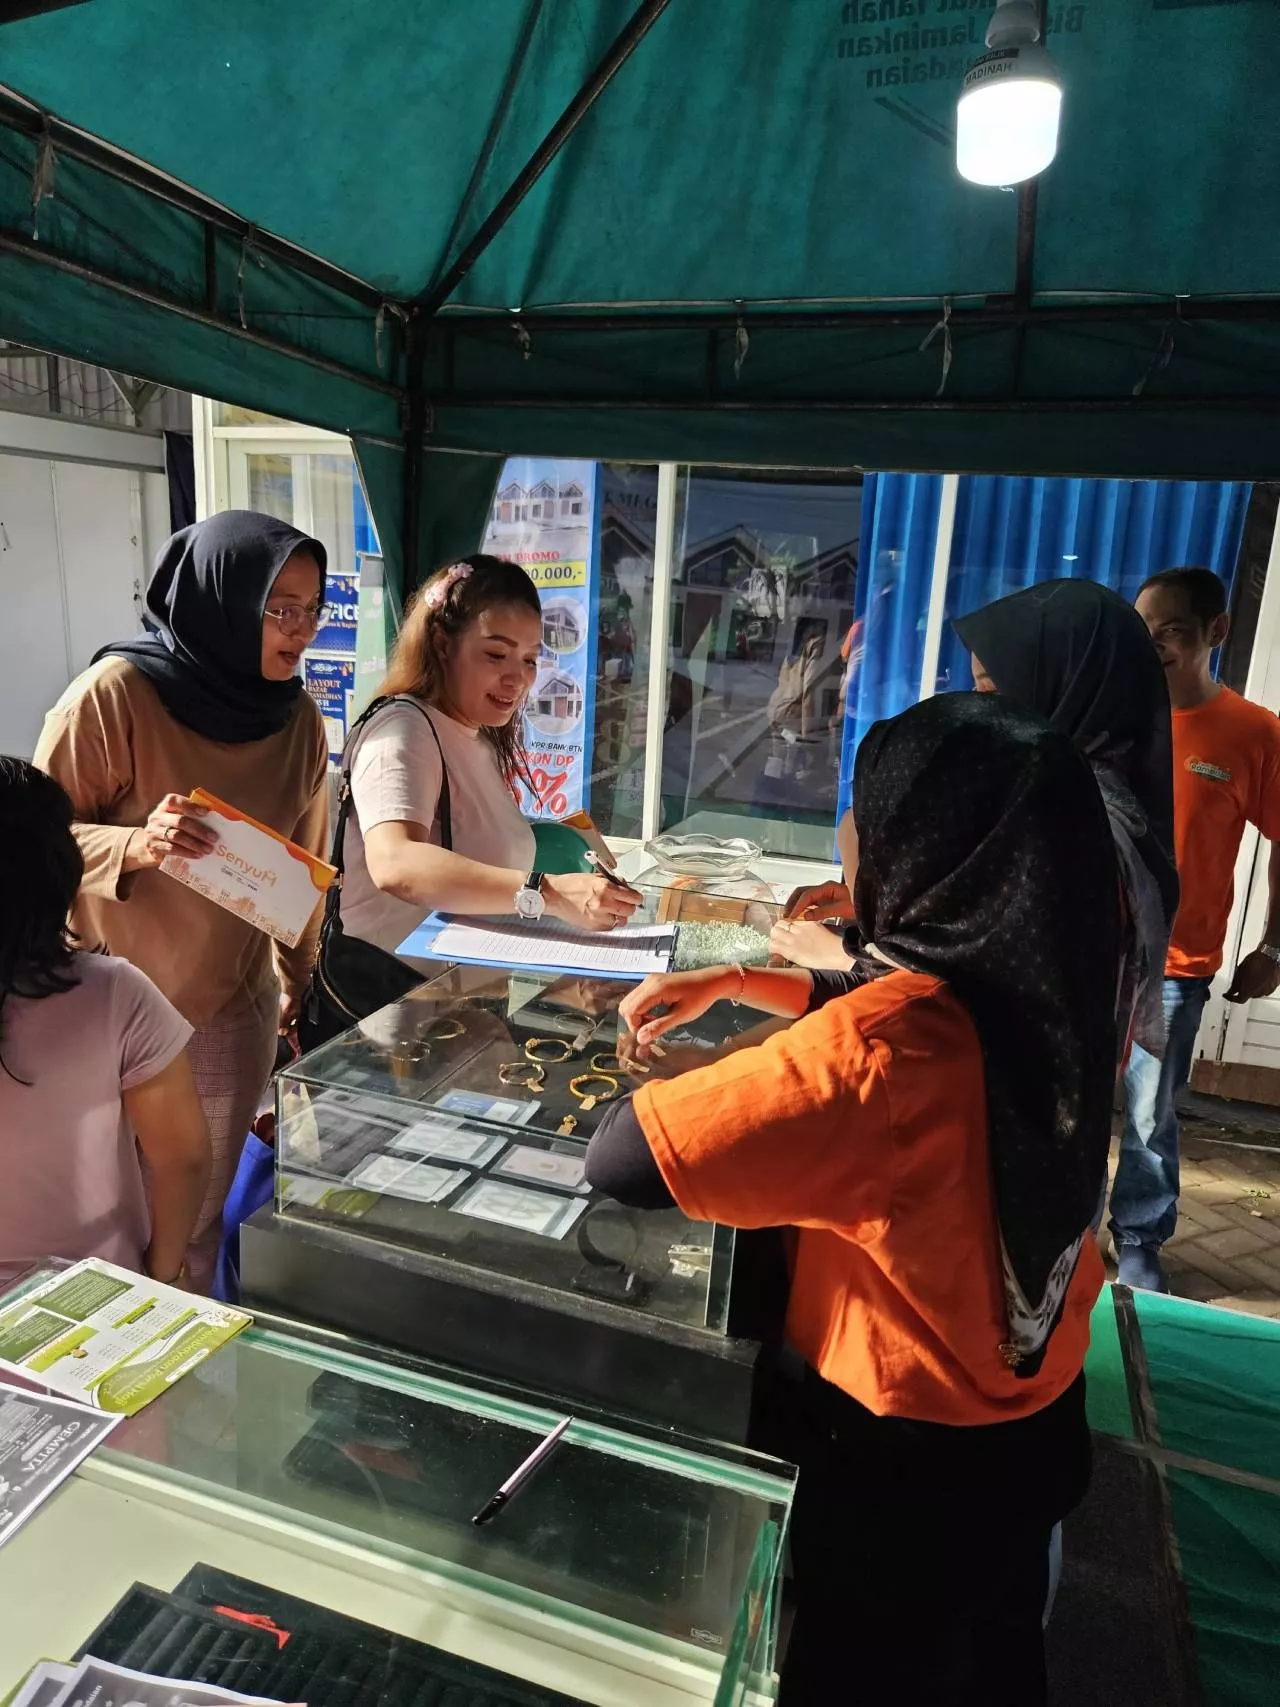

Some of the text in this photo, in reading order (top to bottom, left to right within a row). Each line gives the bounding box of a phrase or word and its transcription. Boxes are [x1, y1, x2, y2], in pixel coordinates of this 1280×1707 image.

[515, 551, 560, 561] PROMO
[308, 678, 342, 688] LAYOUT
[556, 754, 575, 767] DP
[21, 1421, 82, 1473] GEMPITA
